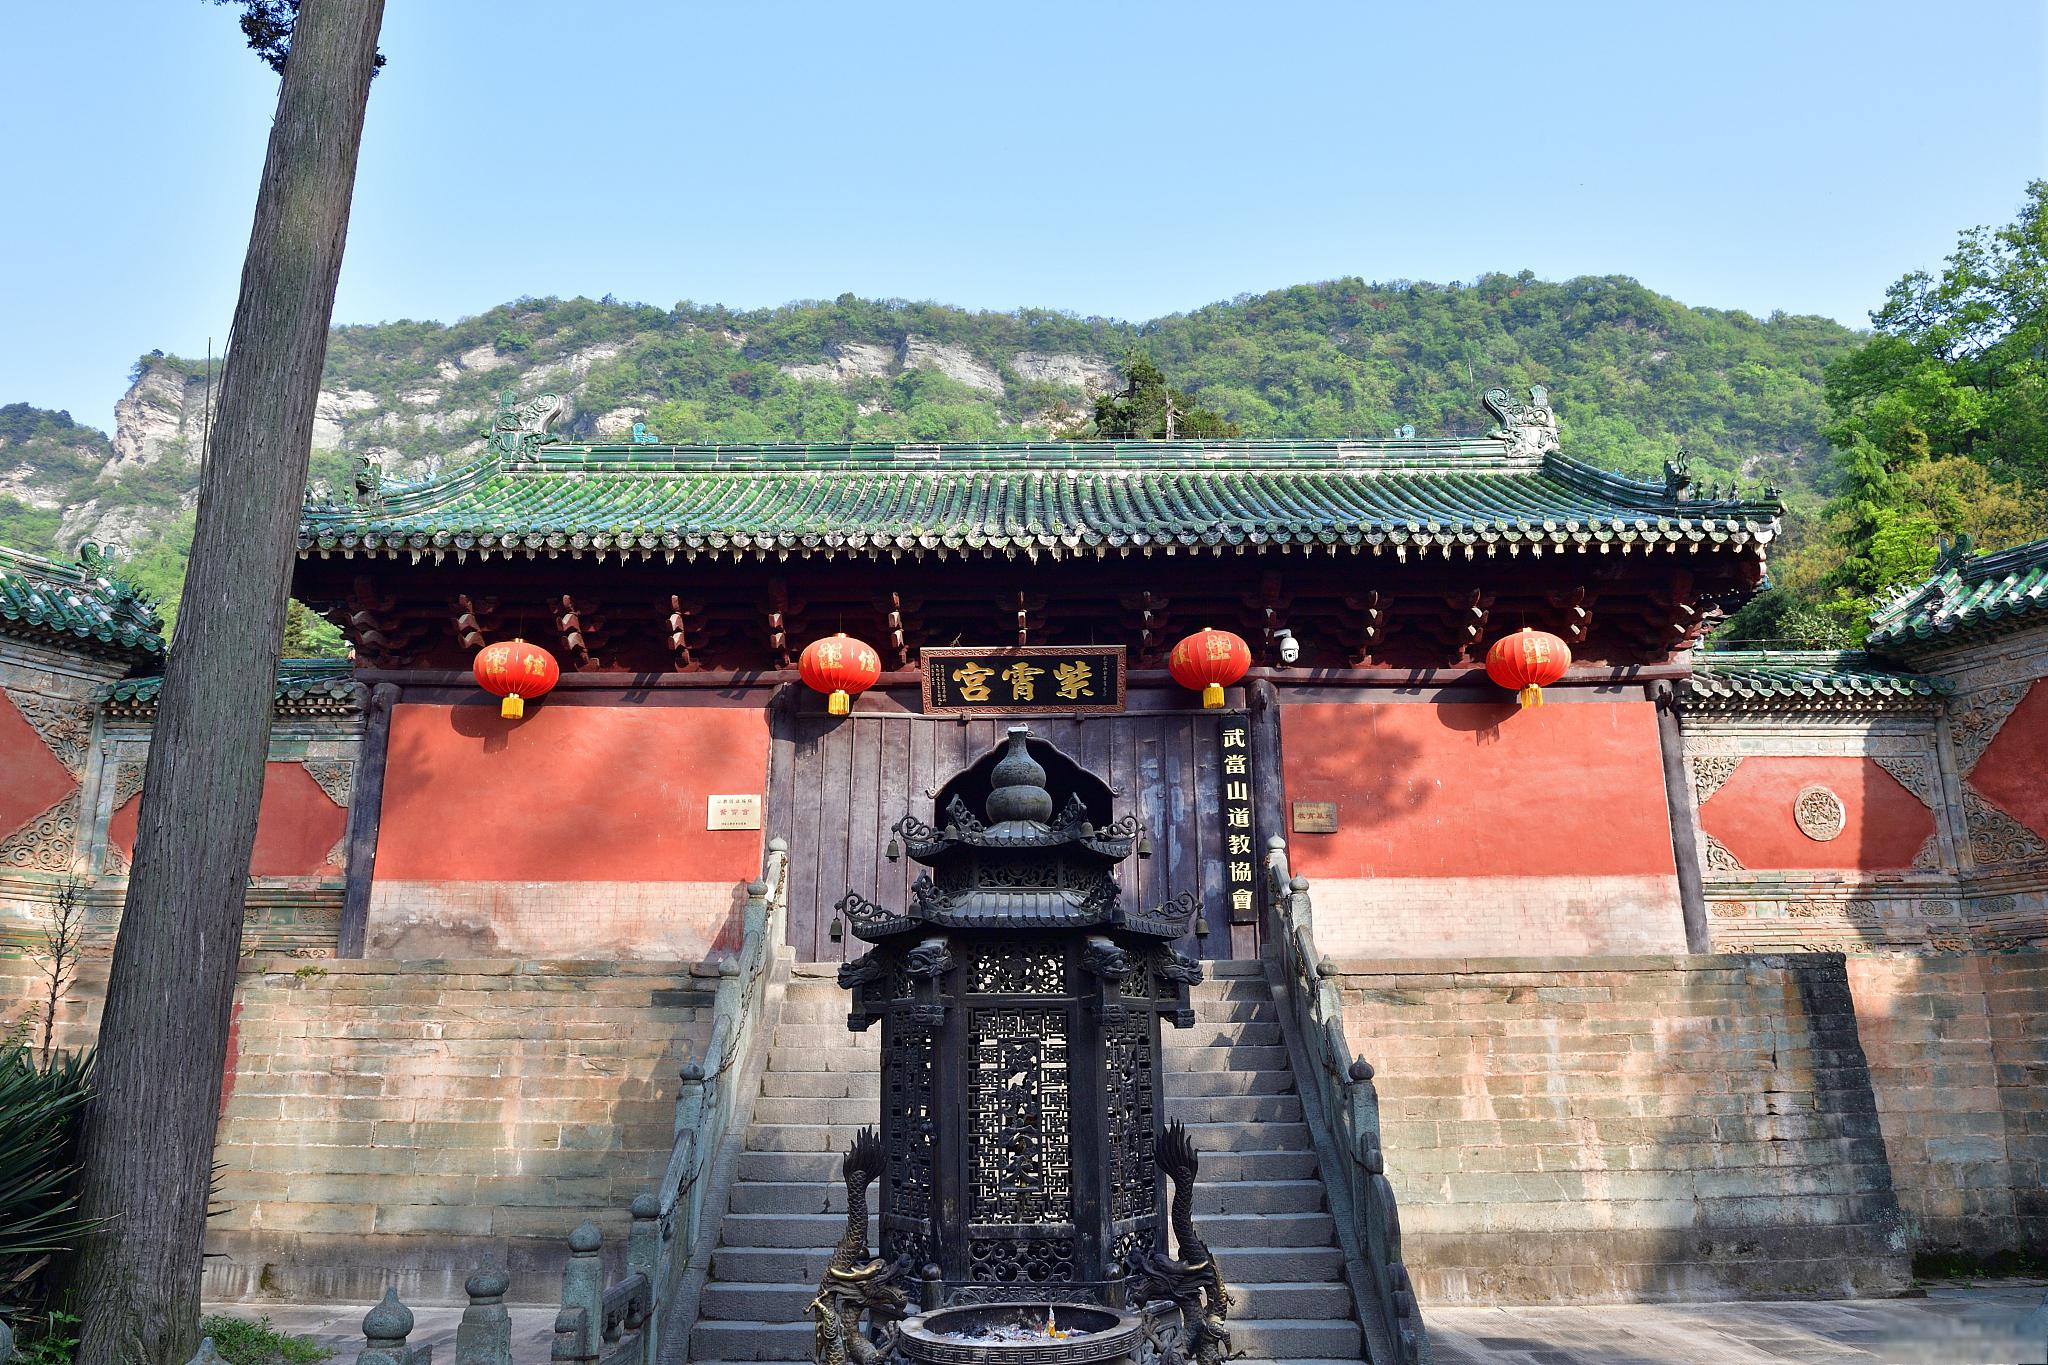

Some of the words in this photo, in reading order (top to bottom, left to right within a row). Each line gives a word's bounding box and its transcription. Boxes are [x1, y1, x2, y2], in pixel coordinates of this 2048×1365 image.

[1222, 728, 1254, 910] 武當山道教協會
